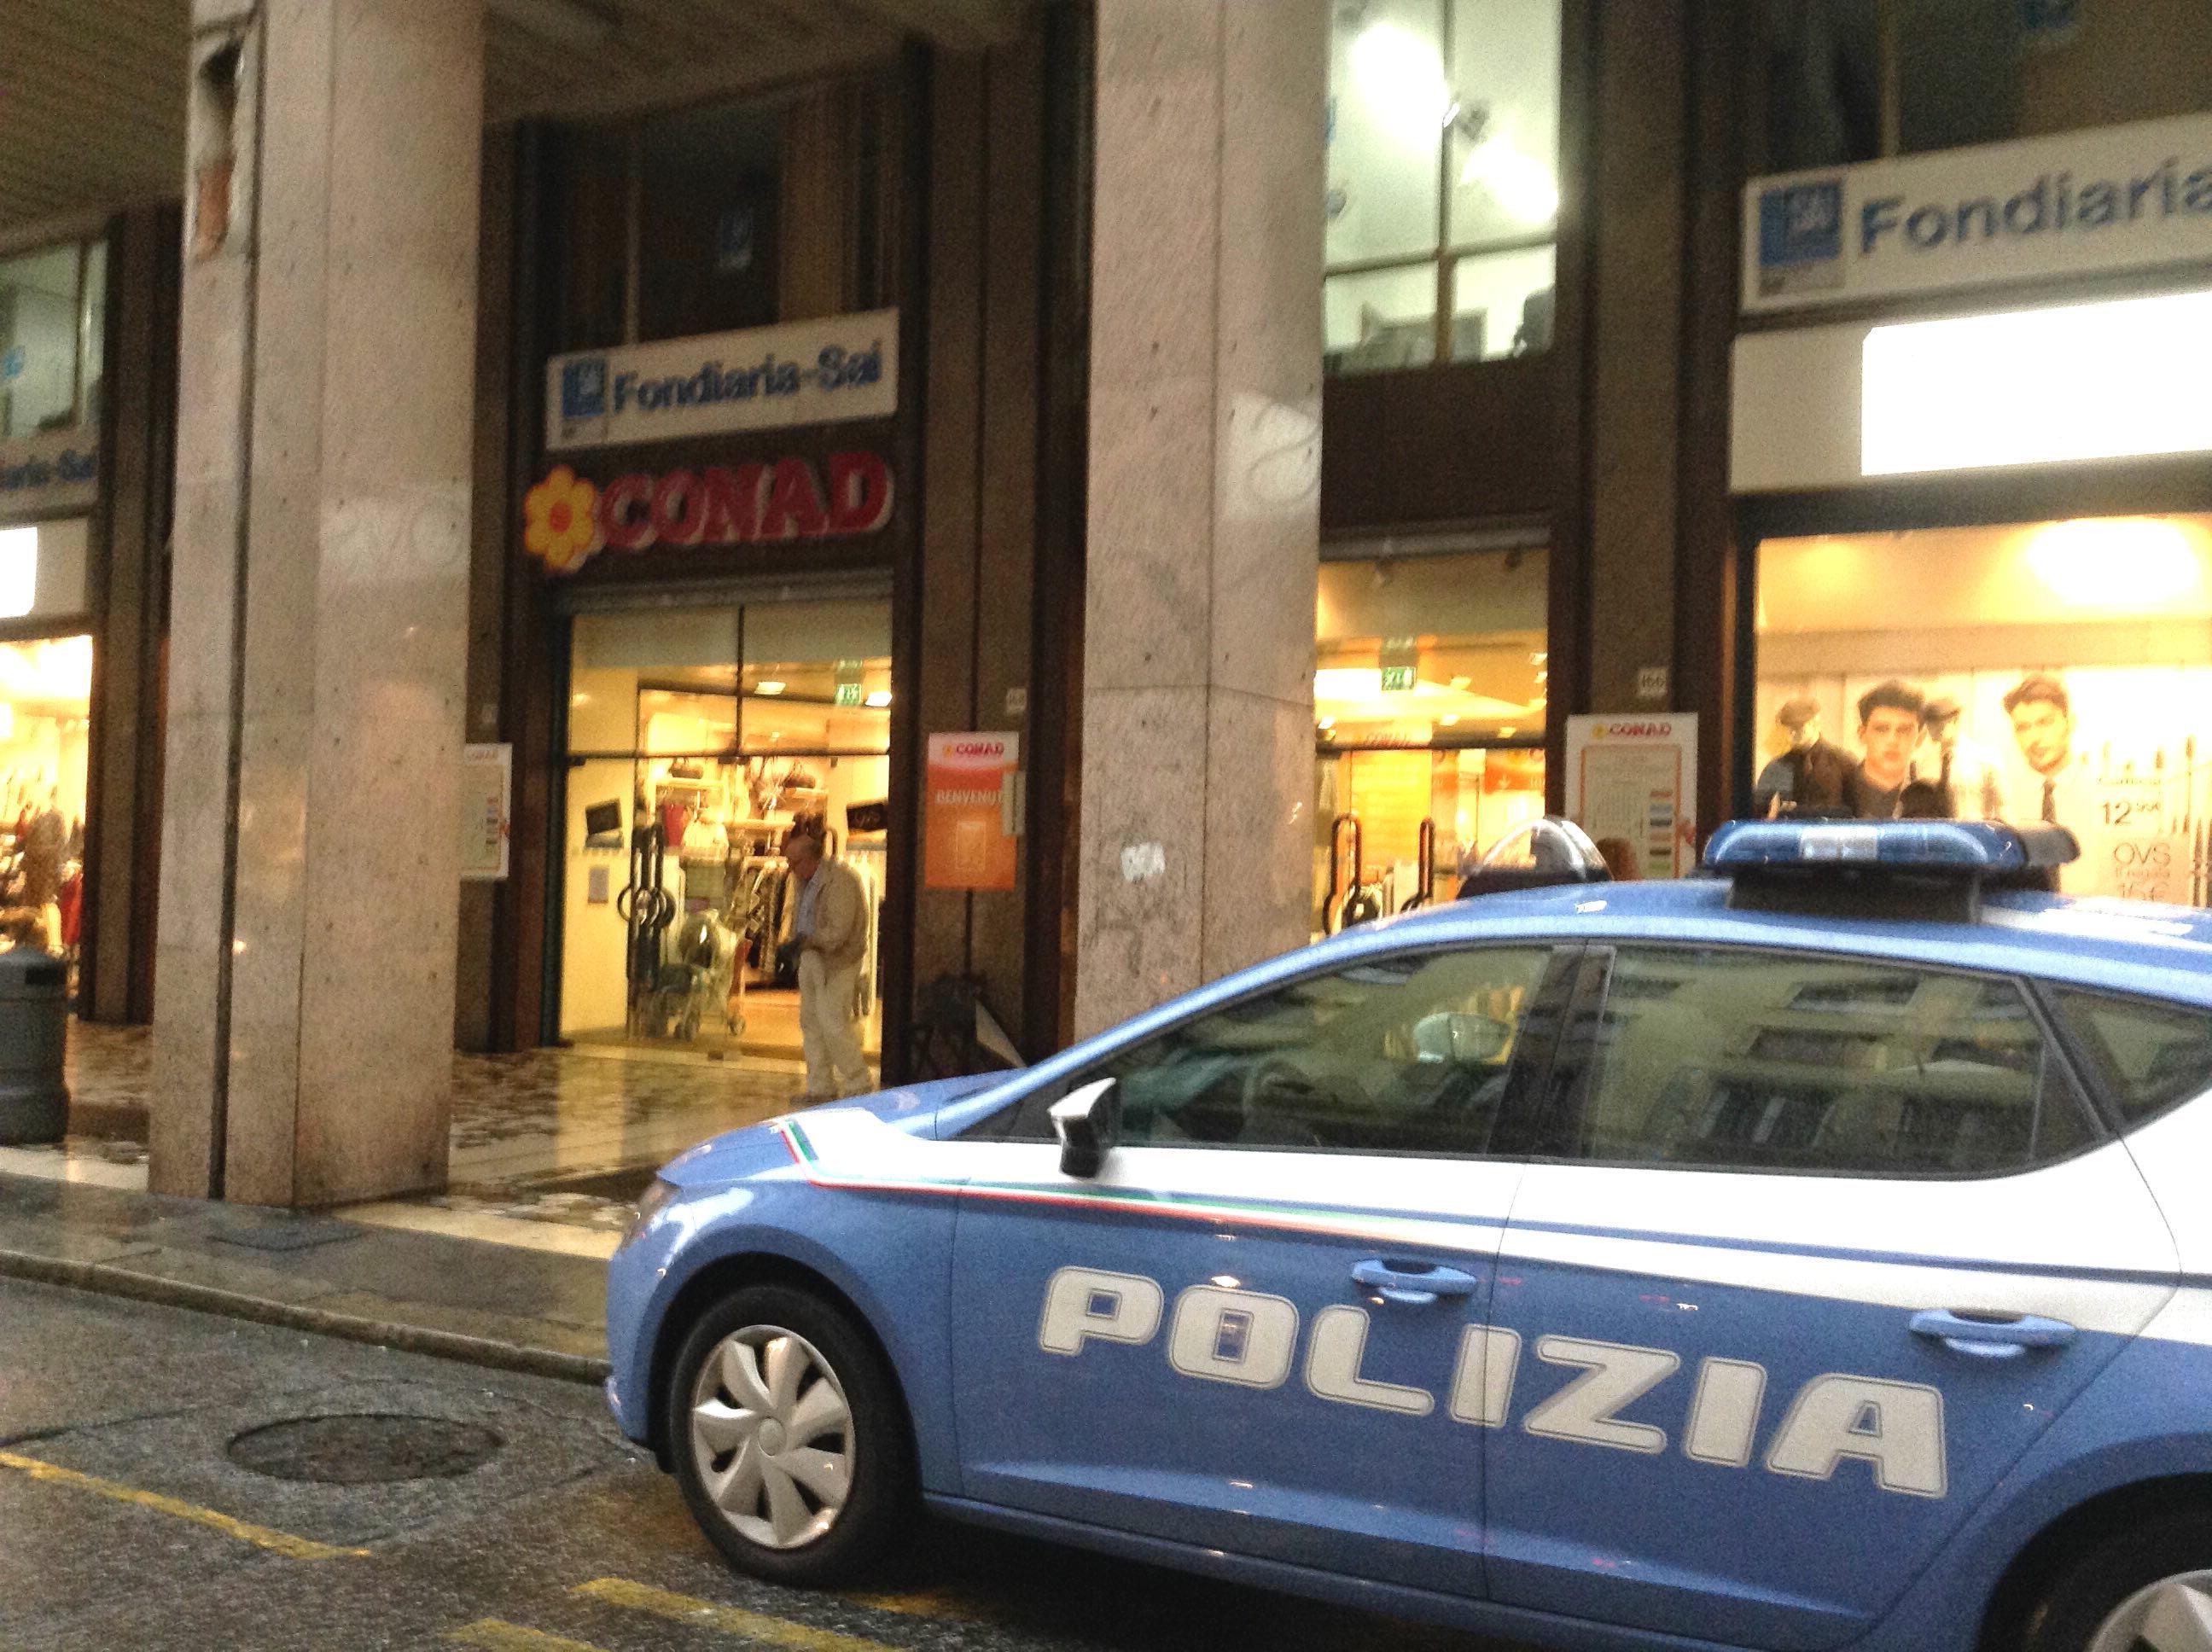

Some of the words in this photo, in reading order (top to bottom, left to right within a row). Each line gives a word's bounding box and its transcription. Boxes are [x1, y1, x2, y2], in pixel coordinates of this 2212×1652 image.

[614, 341, 882, 414] Fondiaria-Sai
[599, 451, 894, 550] CONAD
[956, 742, 1004, 757] CONAD
[1607, 722, 1672, 737] CONAD
[2114, 842, 2171, 866] OVS
[1039, 1265, 1949, 1499] POLIZIA
